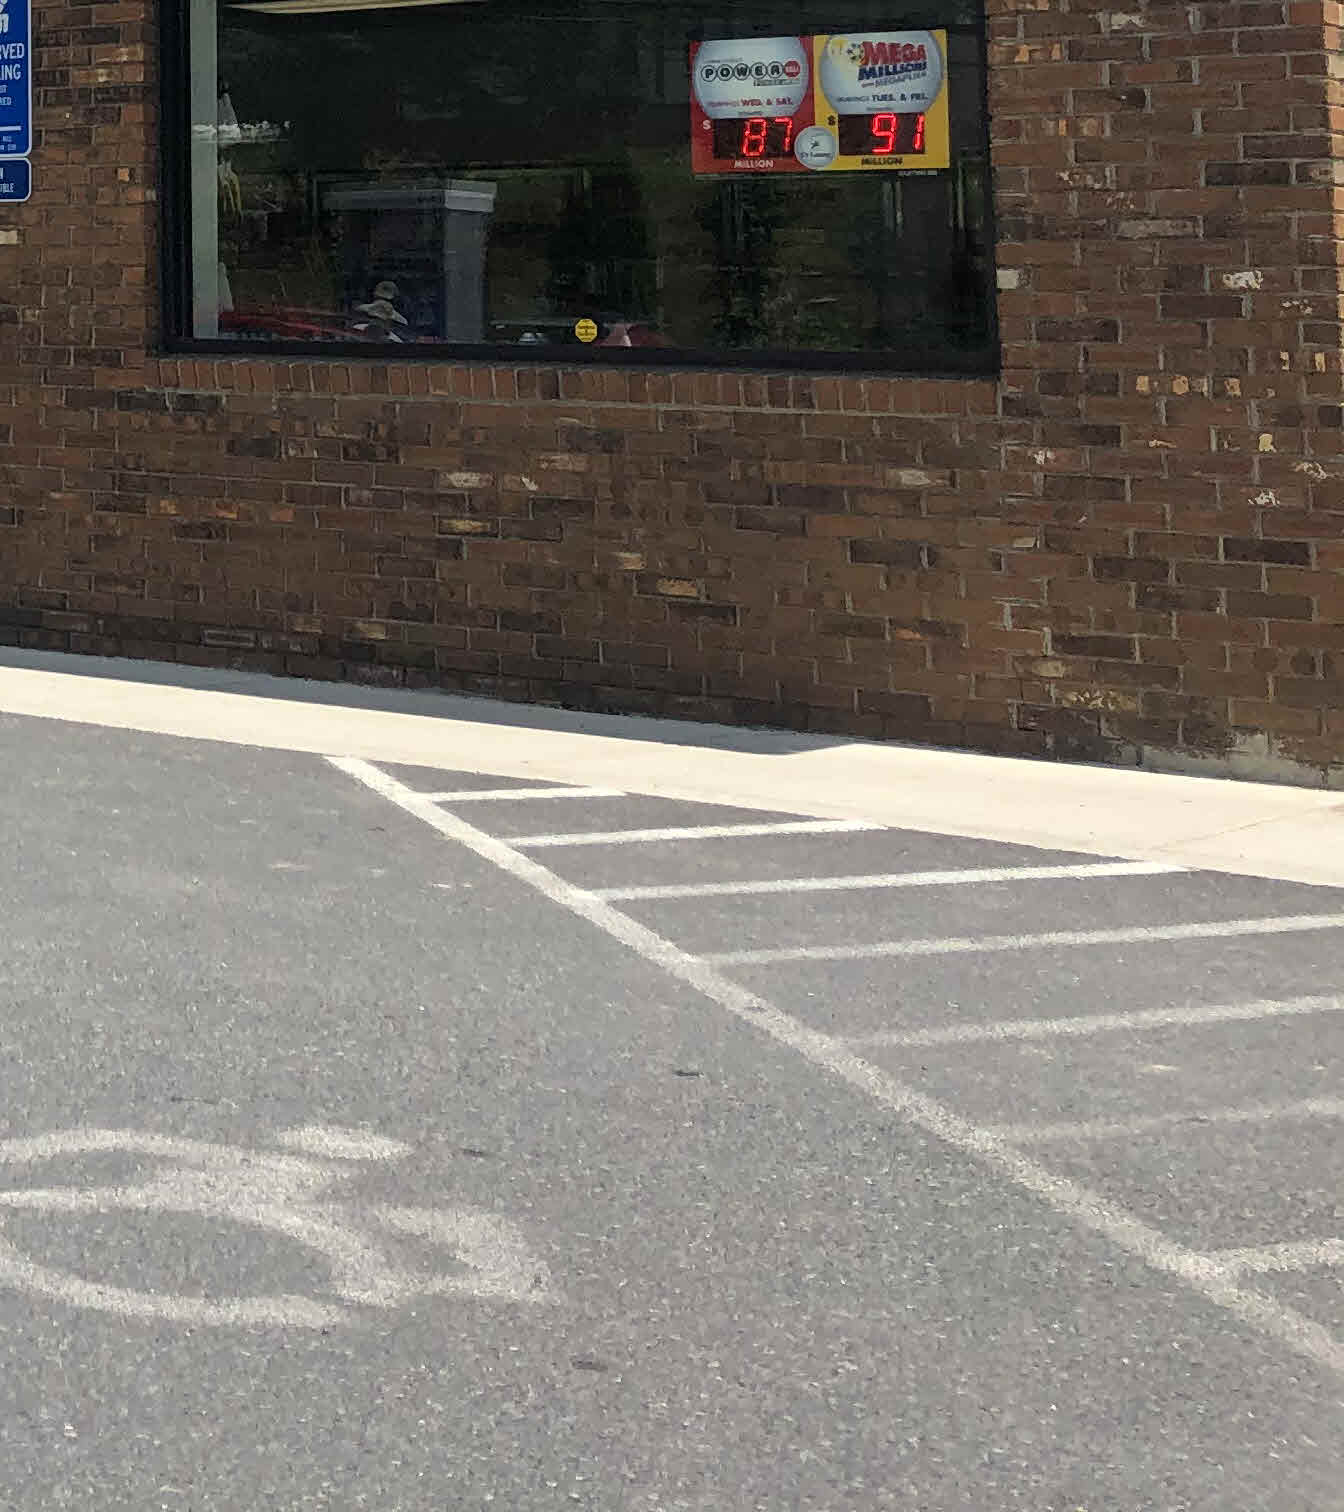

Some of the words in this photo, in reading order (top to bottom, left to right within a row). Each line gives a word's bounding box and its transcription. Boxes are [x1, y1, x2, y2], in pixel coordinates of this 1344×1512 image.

[860, 41, 927, 65] MEGA
[733, 158, 774, 169] MILLION
[861, 157, 904, 167] MILLION
